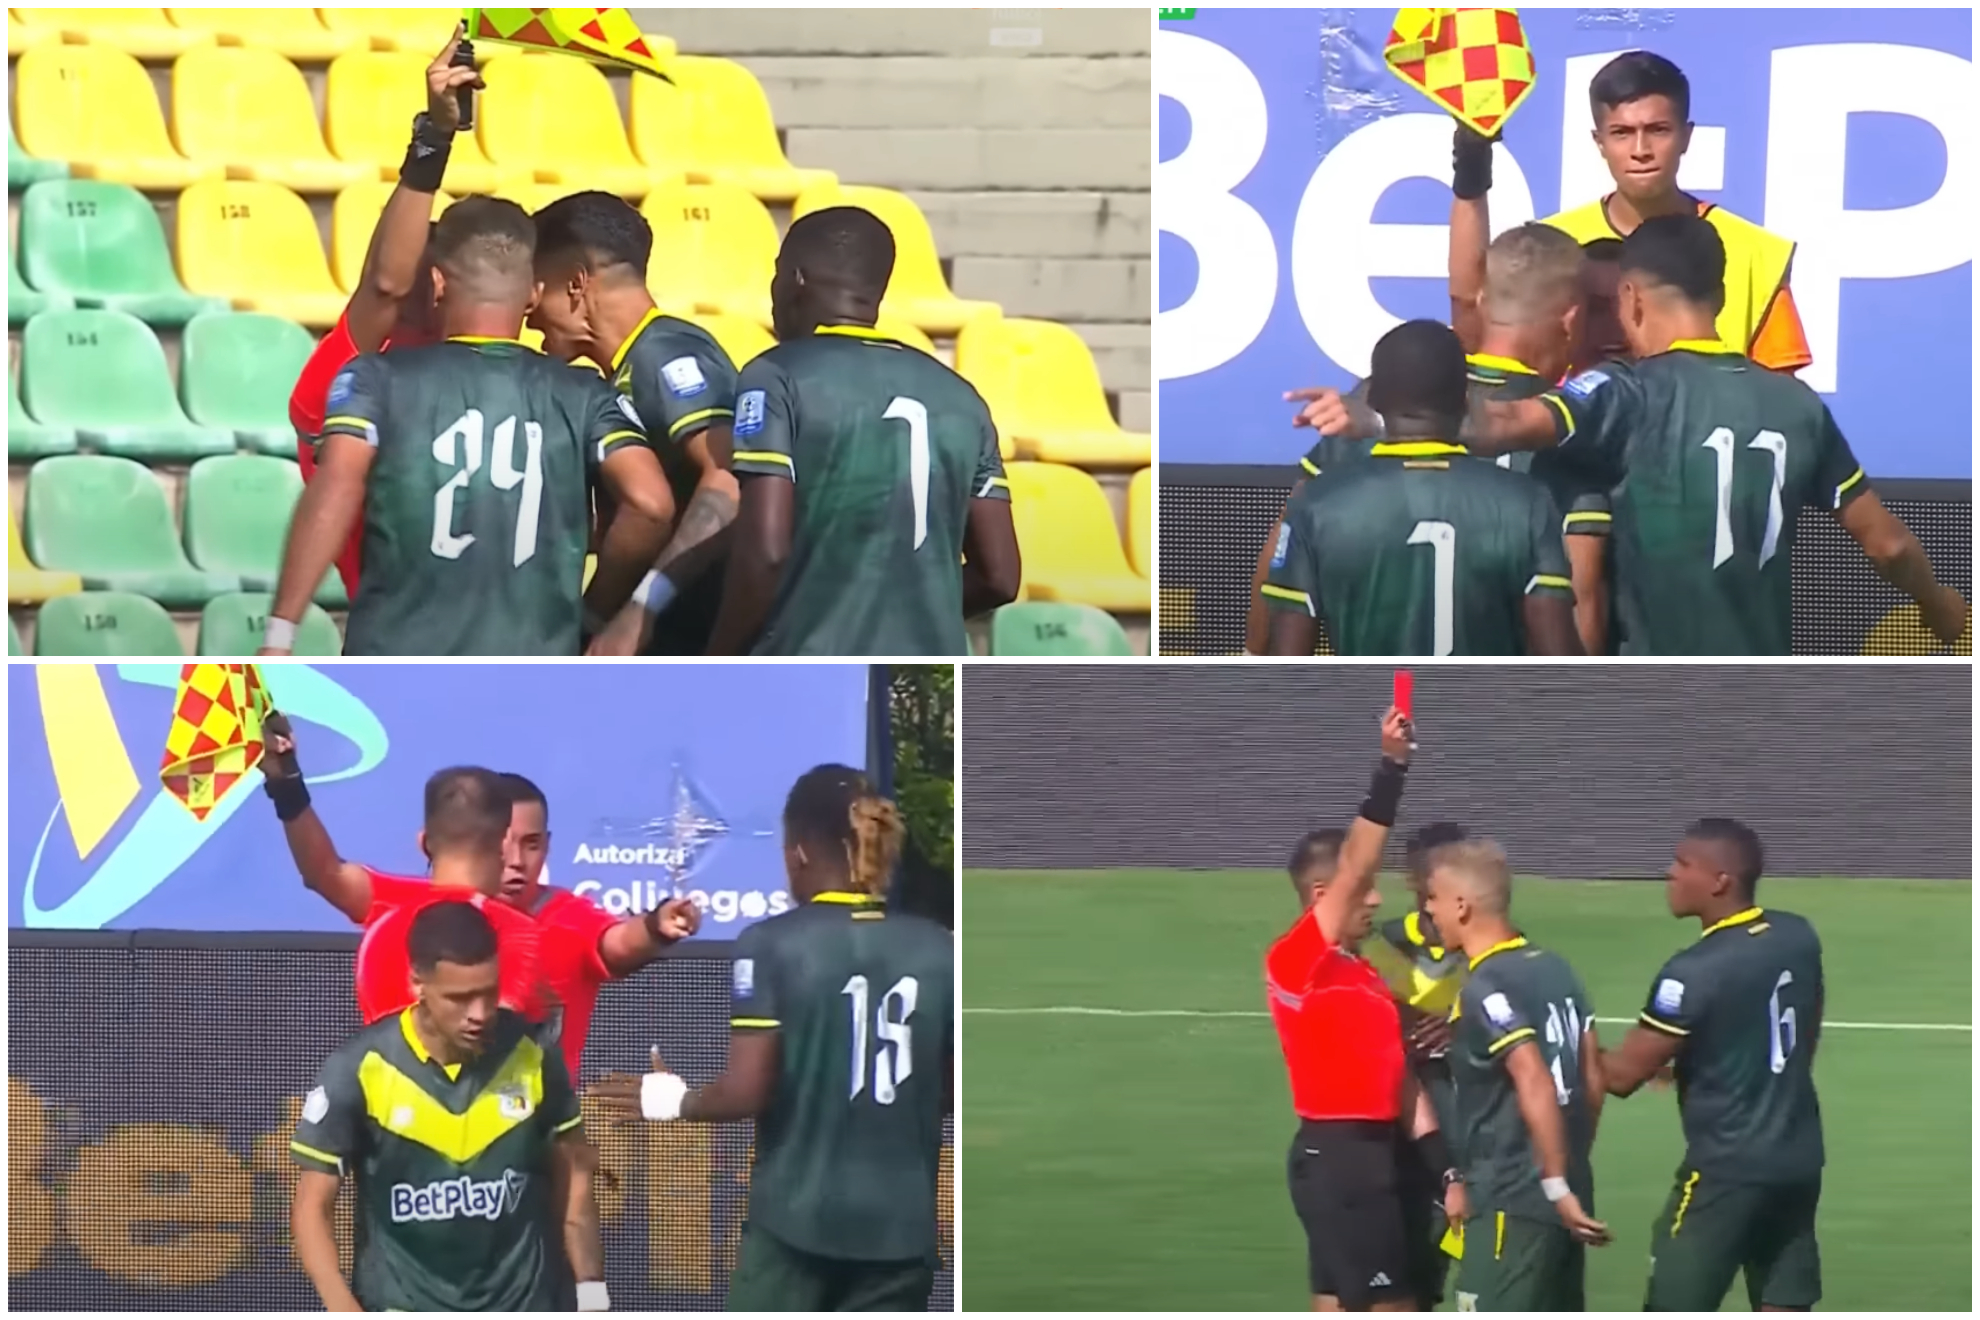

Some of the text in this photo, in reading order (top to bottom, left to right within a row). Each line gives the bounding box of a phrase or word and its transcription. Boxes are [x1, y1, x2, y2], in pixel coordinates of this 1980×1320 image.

[430, 408, 543, 569] 24
[840, 974, 918, 1105] 18
[1769, 969, 1797, 1074] 6
[391, 1176, 506, 1222] BetPlay
